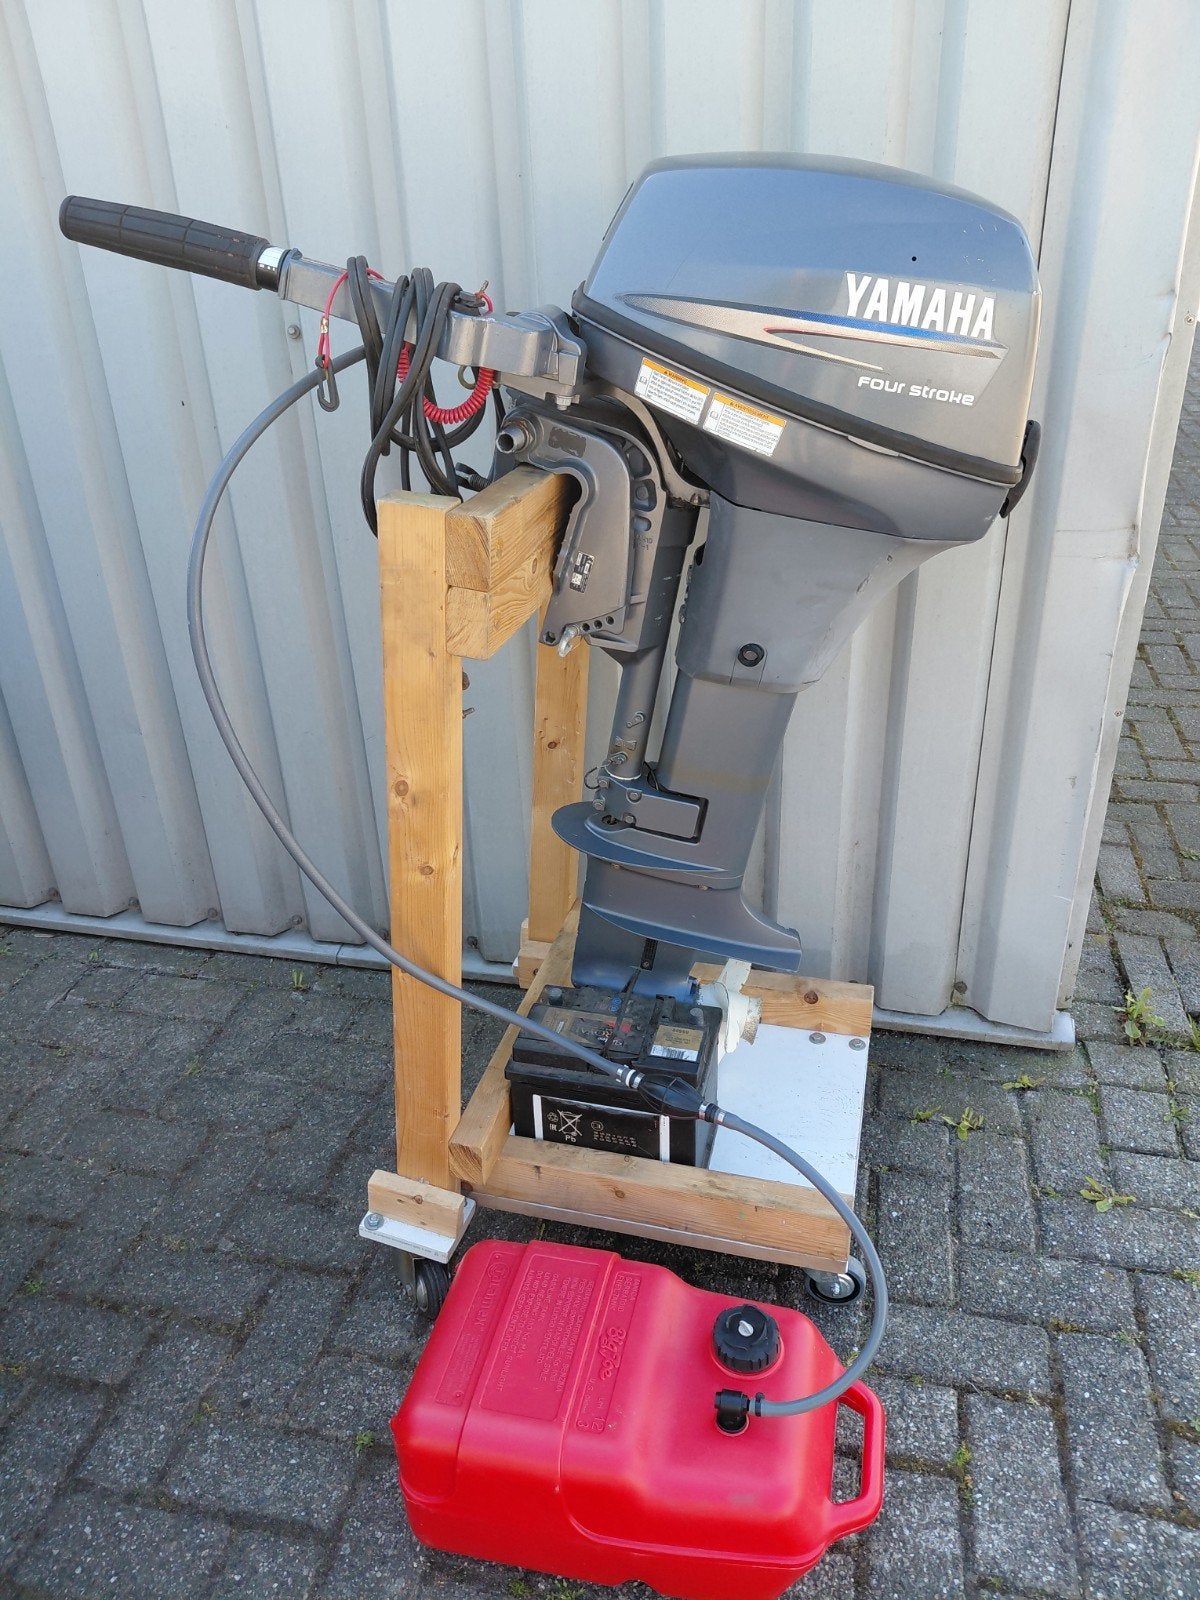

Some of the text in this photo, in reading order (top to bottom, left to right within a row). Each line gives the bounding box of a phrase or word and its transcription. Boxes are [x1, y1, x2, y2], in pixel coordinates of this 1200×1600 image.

[846, 273, 995, 340] YAMAHA
[565, 1135, 577, 1143] Pb
[494, 1354, 513, 1392] SUNLIGHT
[538, 1362, 551, 1381] SOLE
[554, 1362, 570, 1392] BENZINA
[576, 1419, 589, 1428] 3
[590, 1416, 606, 1431] 12
